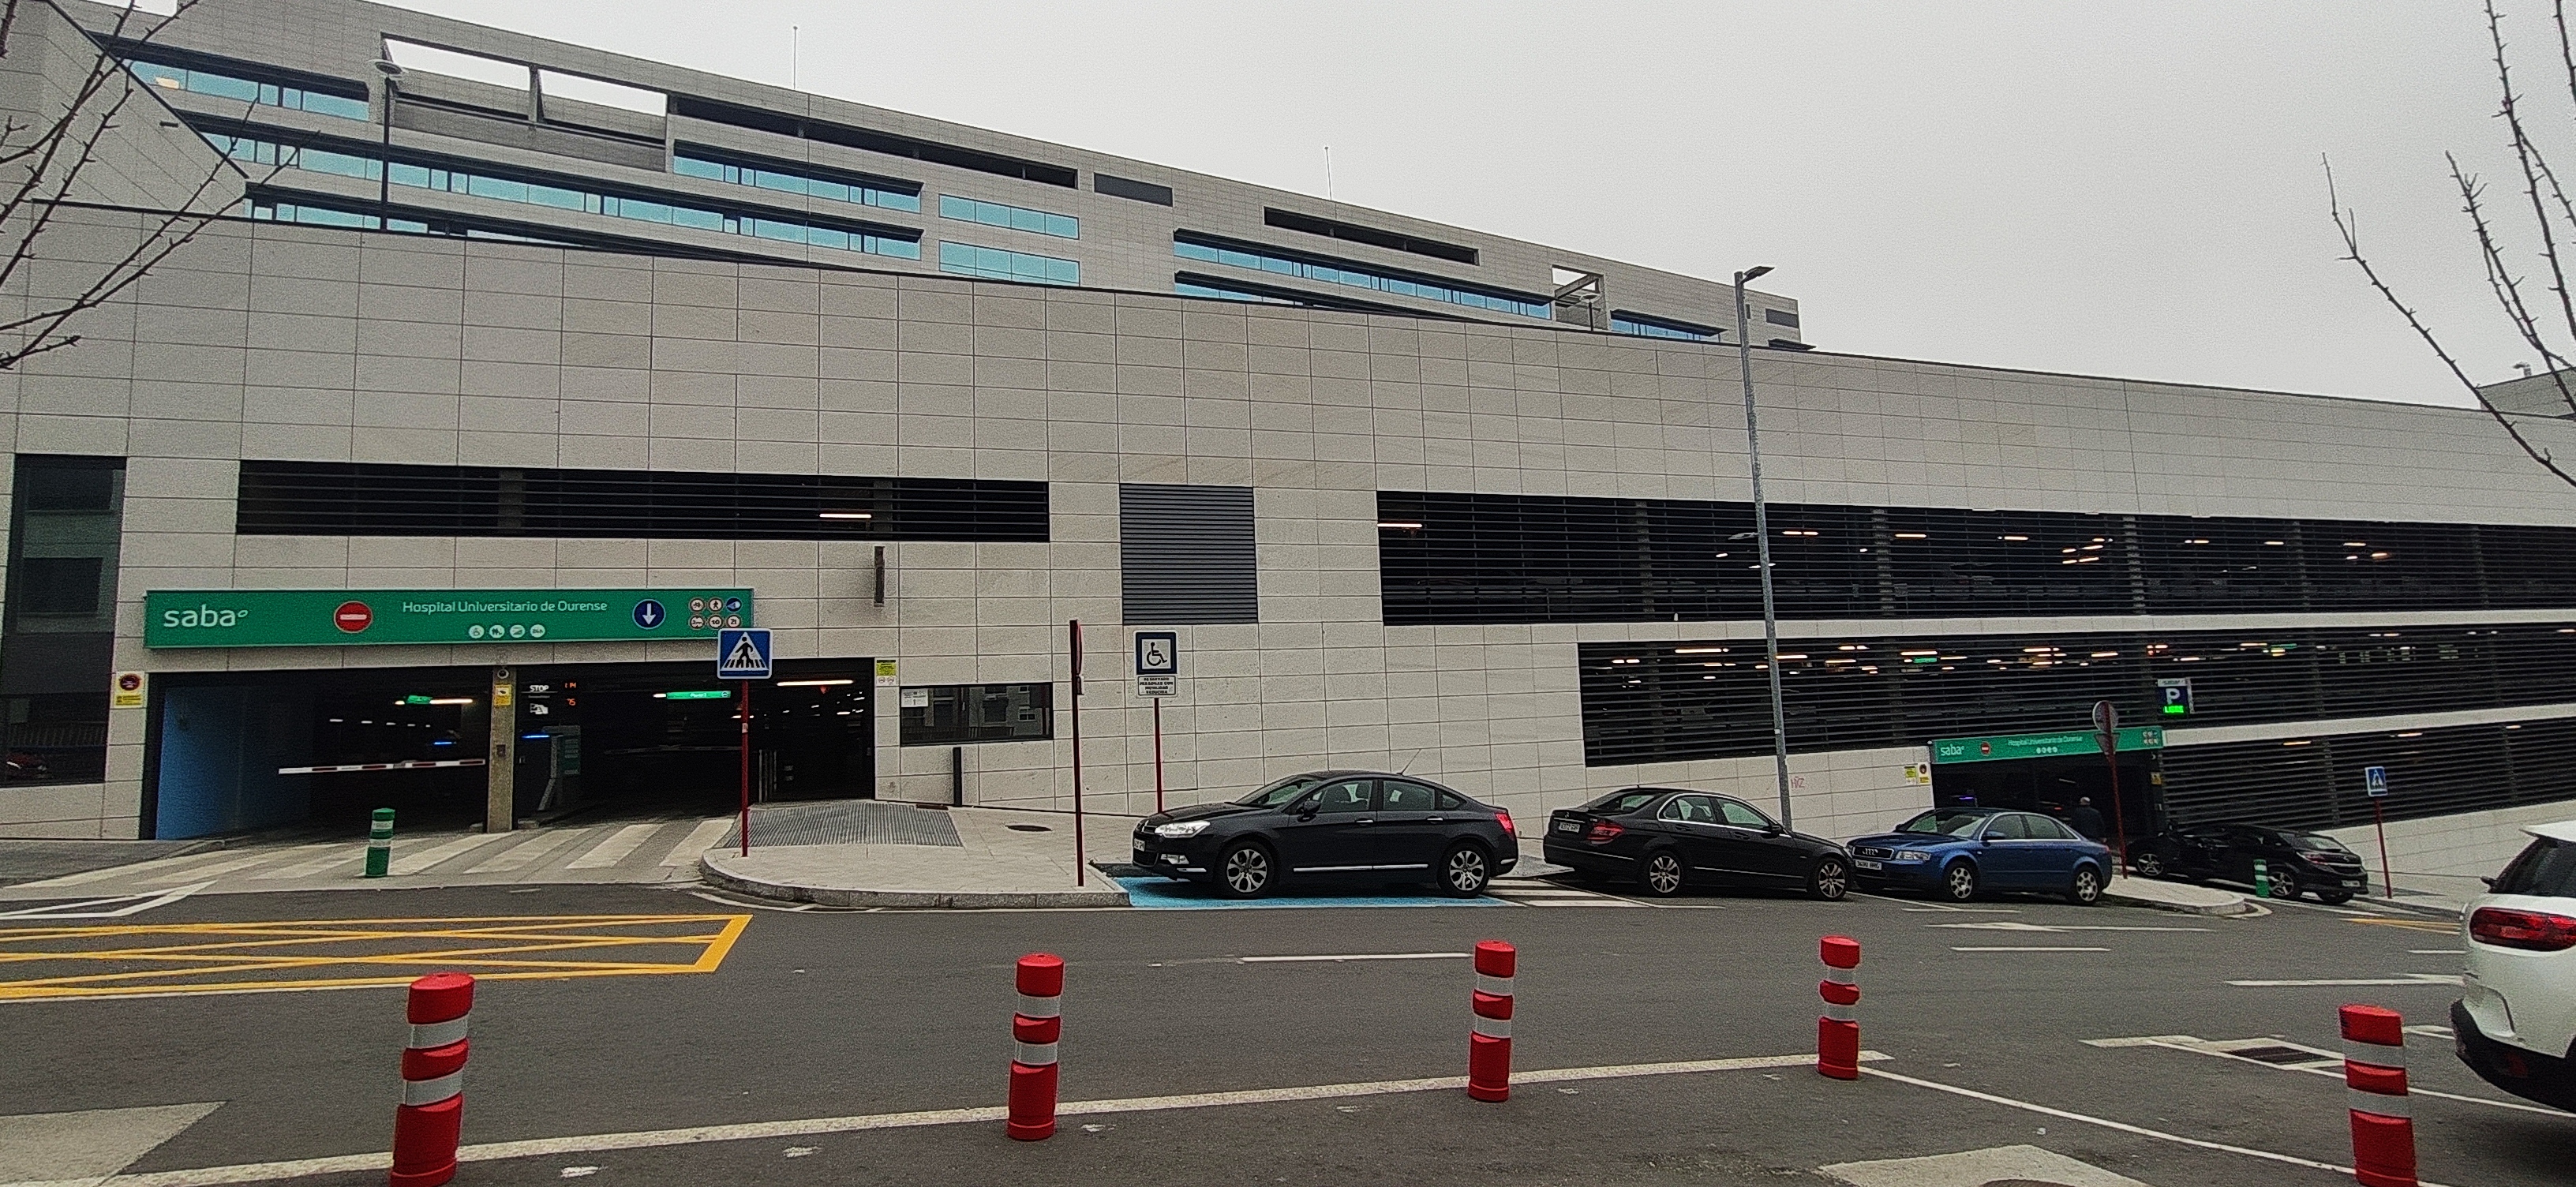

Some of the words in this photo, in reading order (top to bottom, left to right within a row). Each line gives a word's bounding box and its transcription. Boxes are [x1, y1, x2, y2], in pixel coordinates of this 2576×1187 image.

[163, 604, 236, 627] saba
[402, 601, 455, 615] Hospital
[458, 600, 538, 612] Universitario
[540, 600, 556, 612] de
[557, 600, 608, 612] Ourense
[530, 684, 550, 693] STOP
[2165, 687, 2181, 705] P
